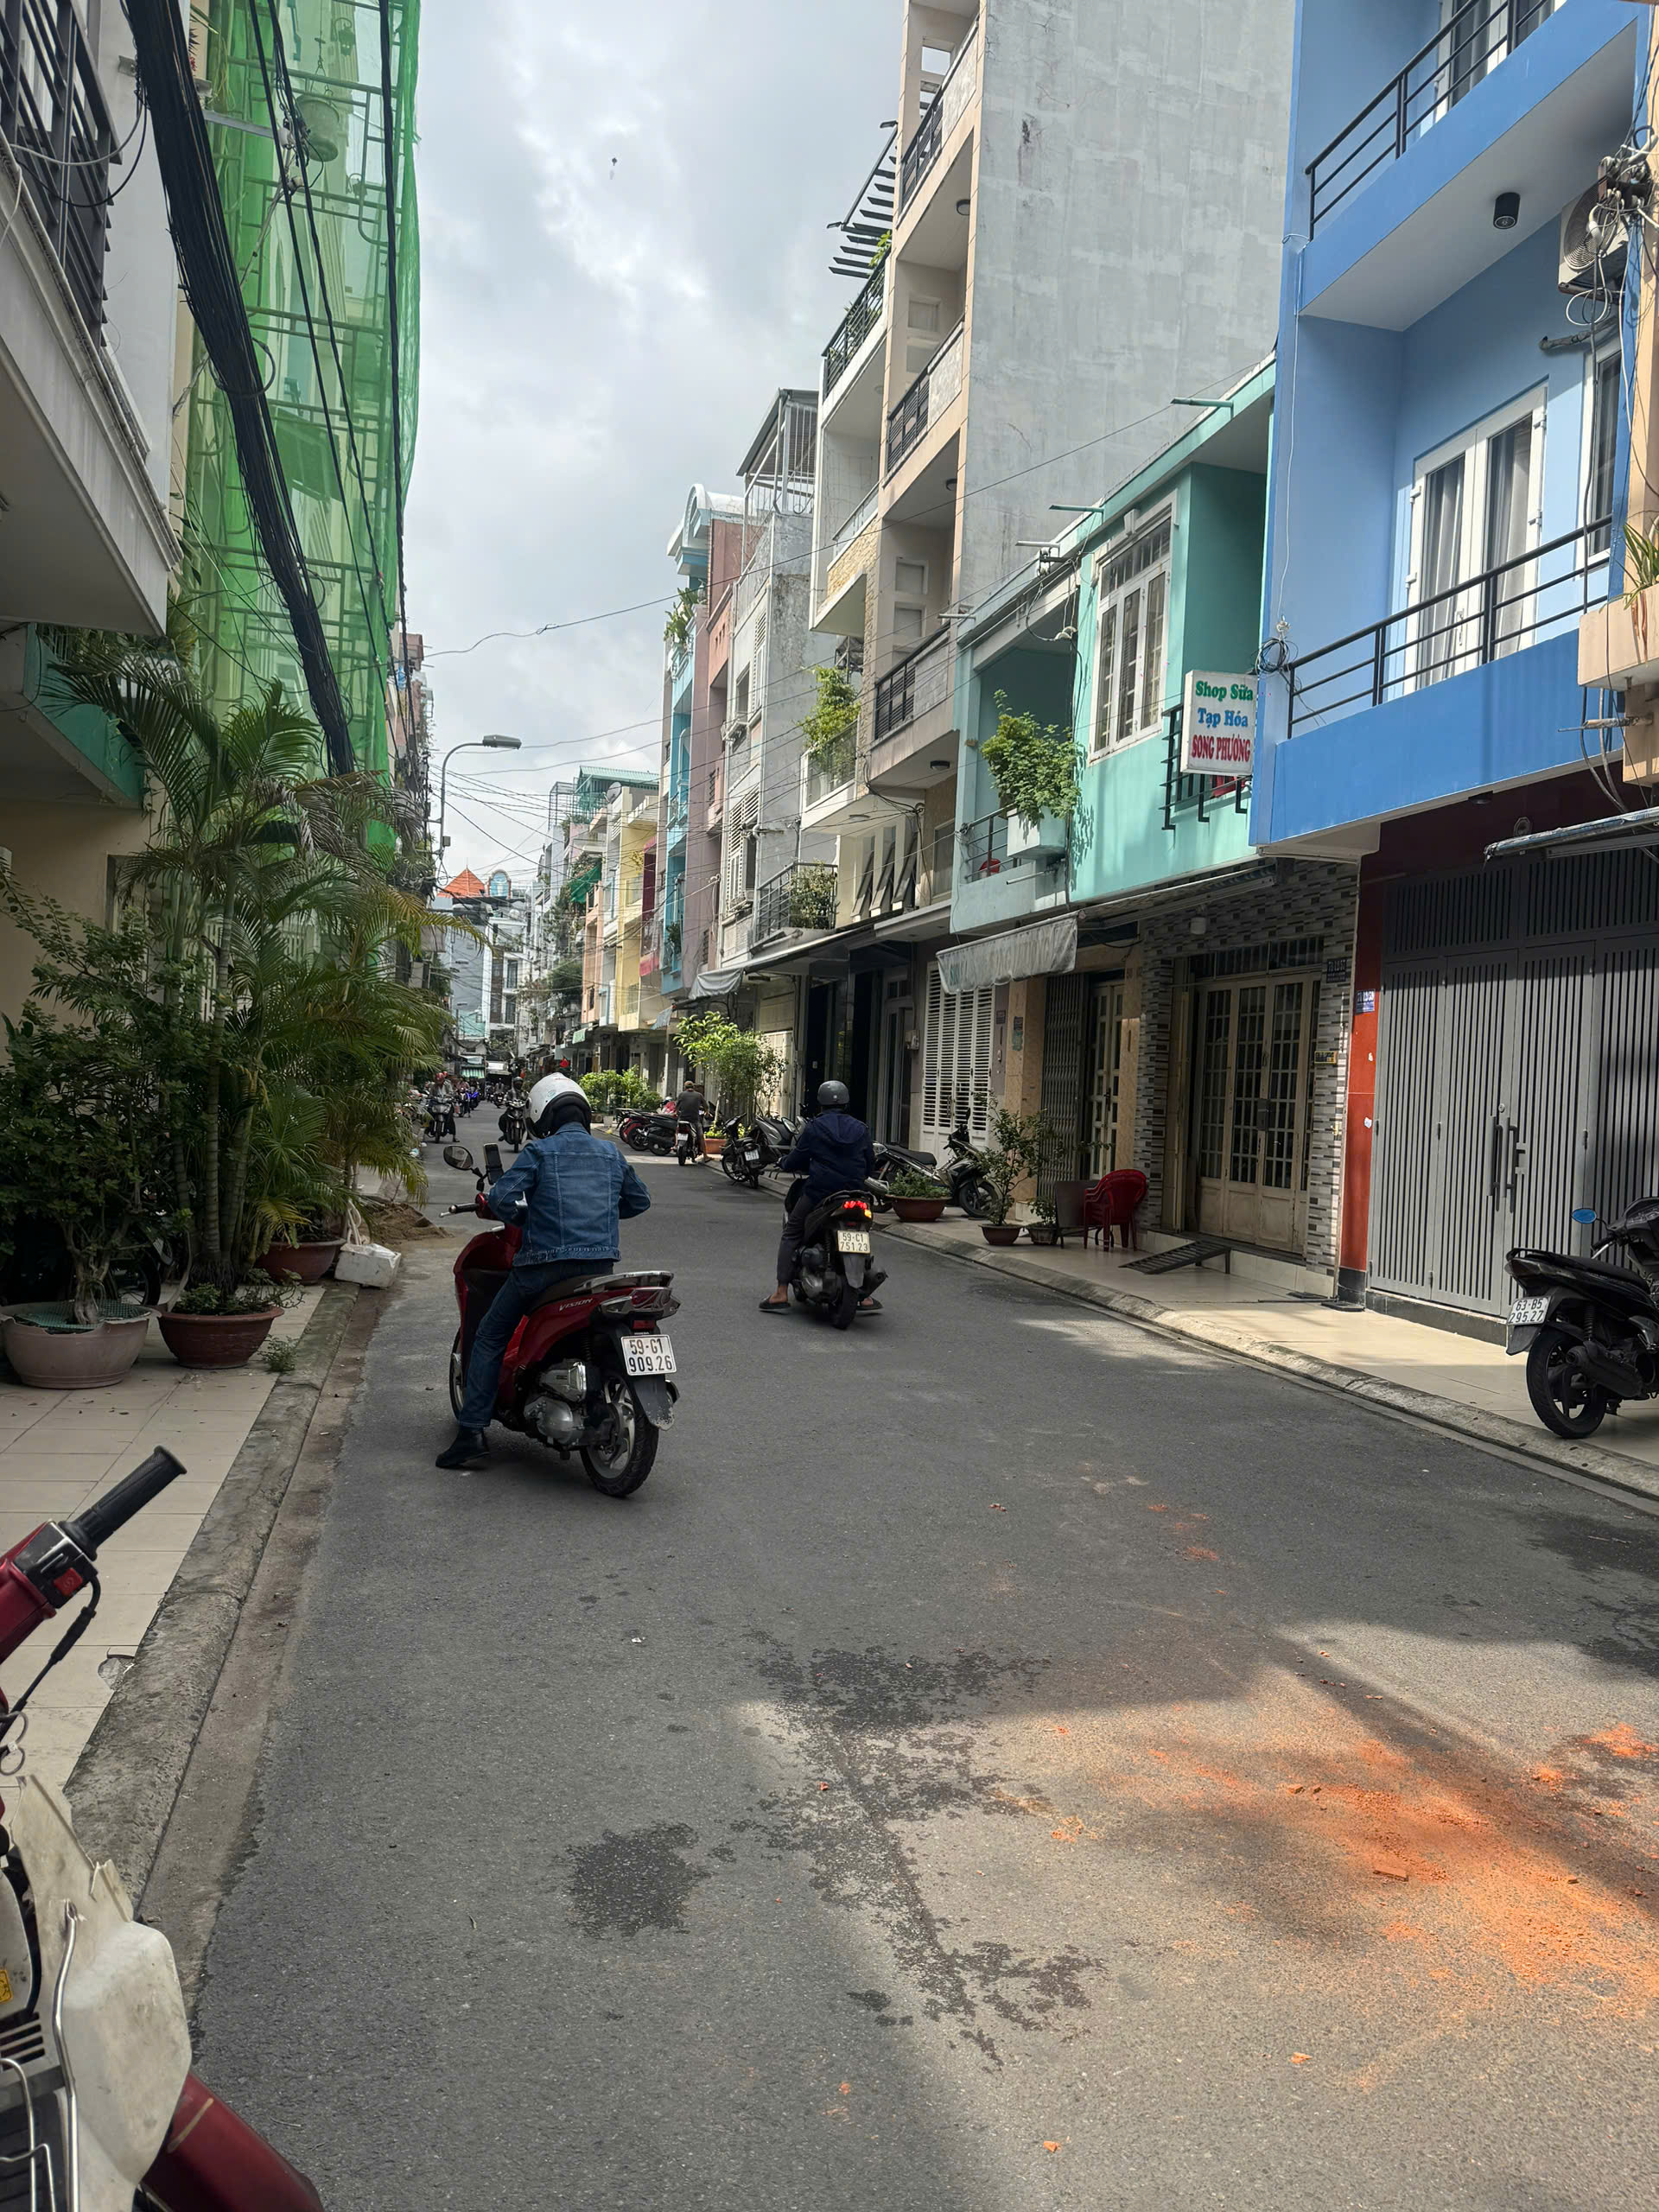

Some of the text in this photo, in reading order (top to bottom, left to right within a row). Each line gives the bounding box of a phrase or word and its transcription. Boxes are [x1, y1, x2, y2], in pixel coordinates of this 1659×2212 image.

[1196, 681, 1253, 702] Shop Sữa
[1198, 708, 1248, 728] Tạp Hóa
[1192, 734, 1215, 760] SONG
[1508, 1310, 1544, 1324] 295.27
[629, 1338, 664, 1355] 59-G1
[628, 1355, 672, 1372] 909.26
